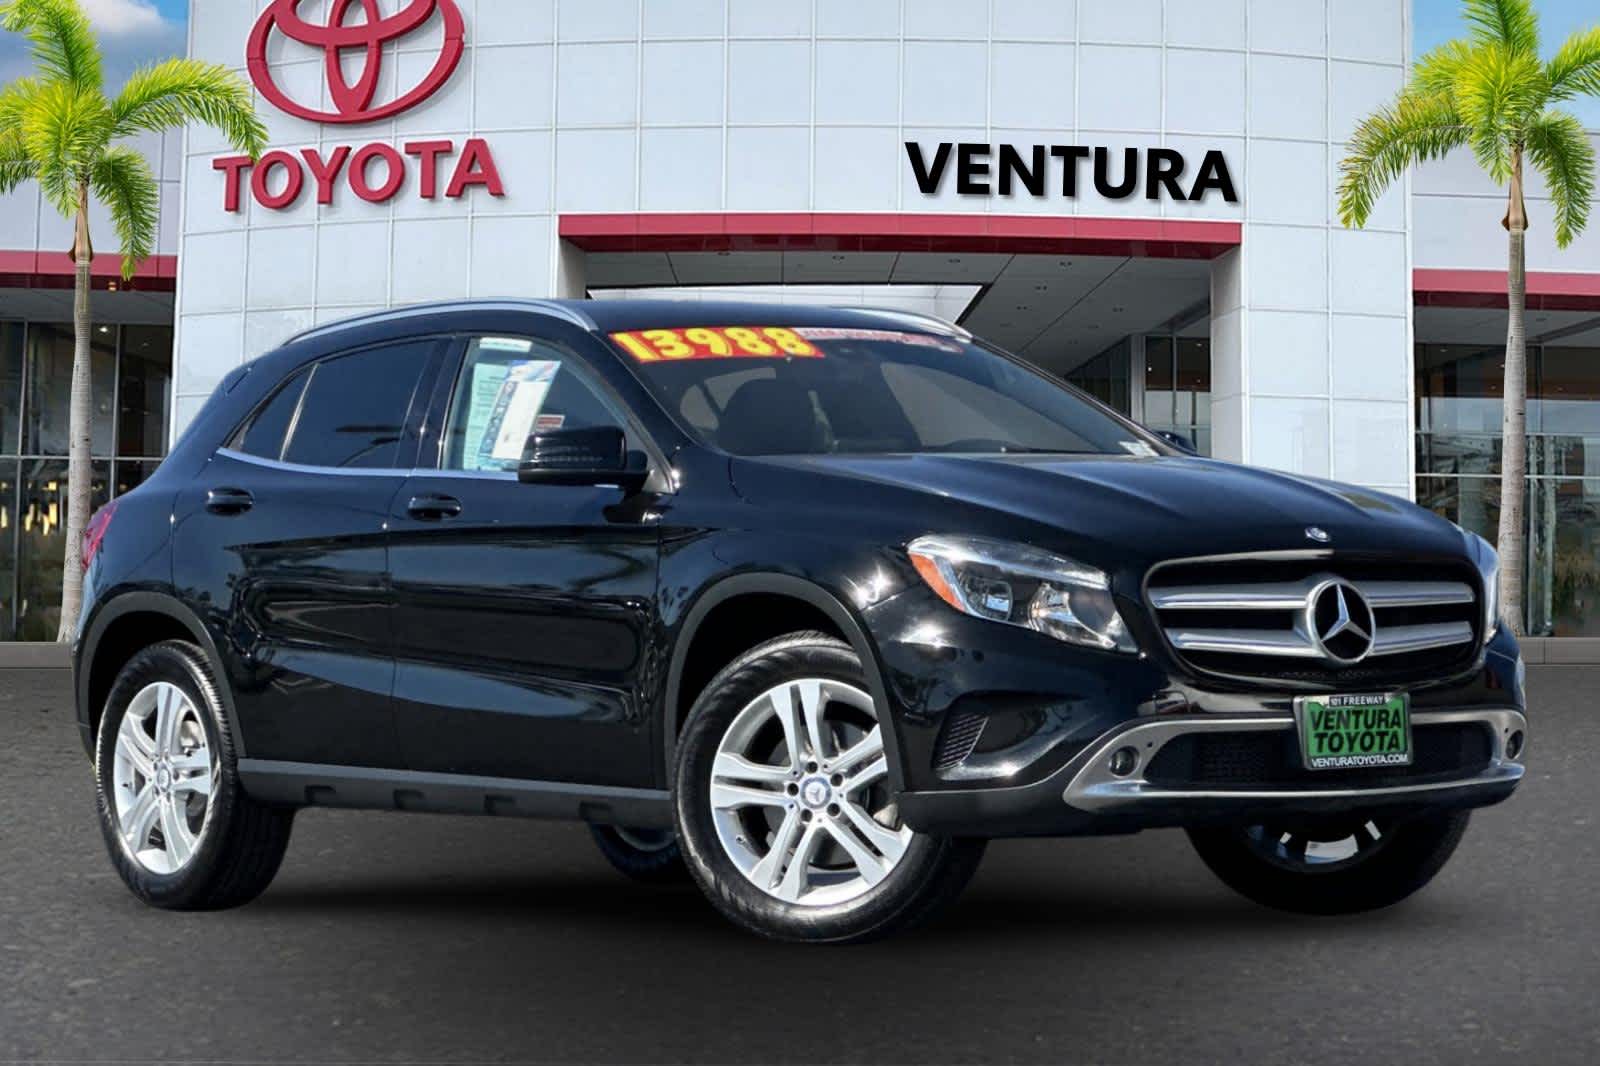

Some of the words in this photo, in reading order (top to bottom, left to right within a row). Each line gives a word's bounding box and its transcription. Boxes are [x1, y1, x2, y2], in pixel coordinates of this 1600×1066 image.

[213, 138, 505, 212] TOYOTA
[904, 141, 1240, 202] VENTURA
[613, 326, 815, 361] 13988
[1343, 696, 1384, 705] FREEWAY
[1311, 709, 1401, 730] VENTURA
[1315, 731, 1400, 752] TOYOTA
[1311, 754, 1408, 768] VENTURATOYOTA.COM
